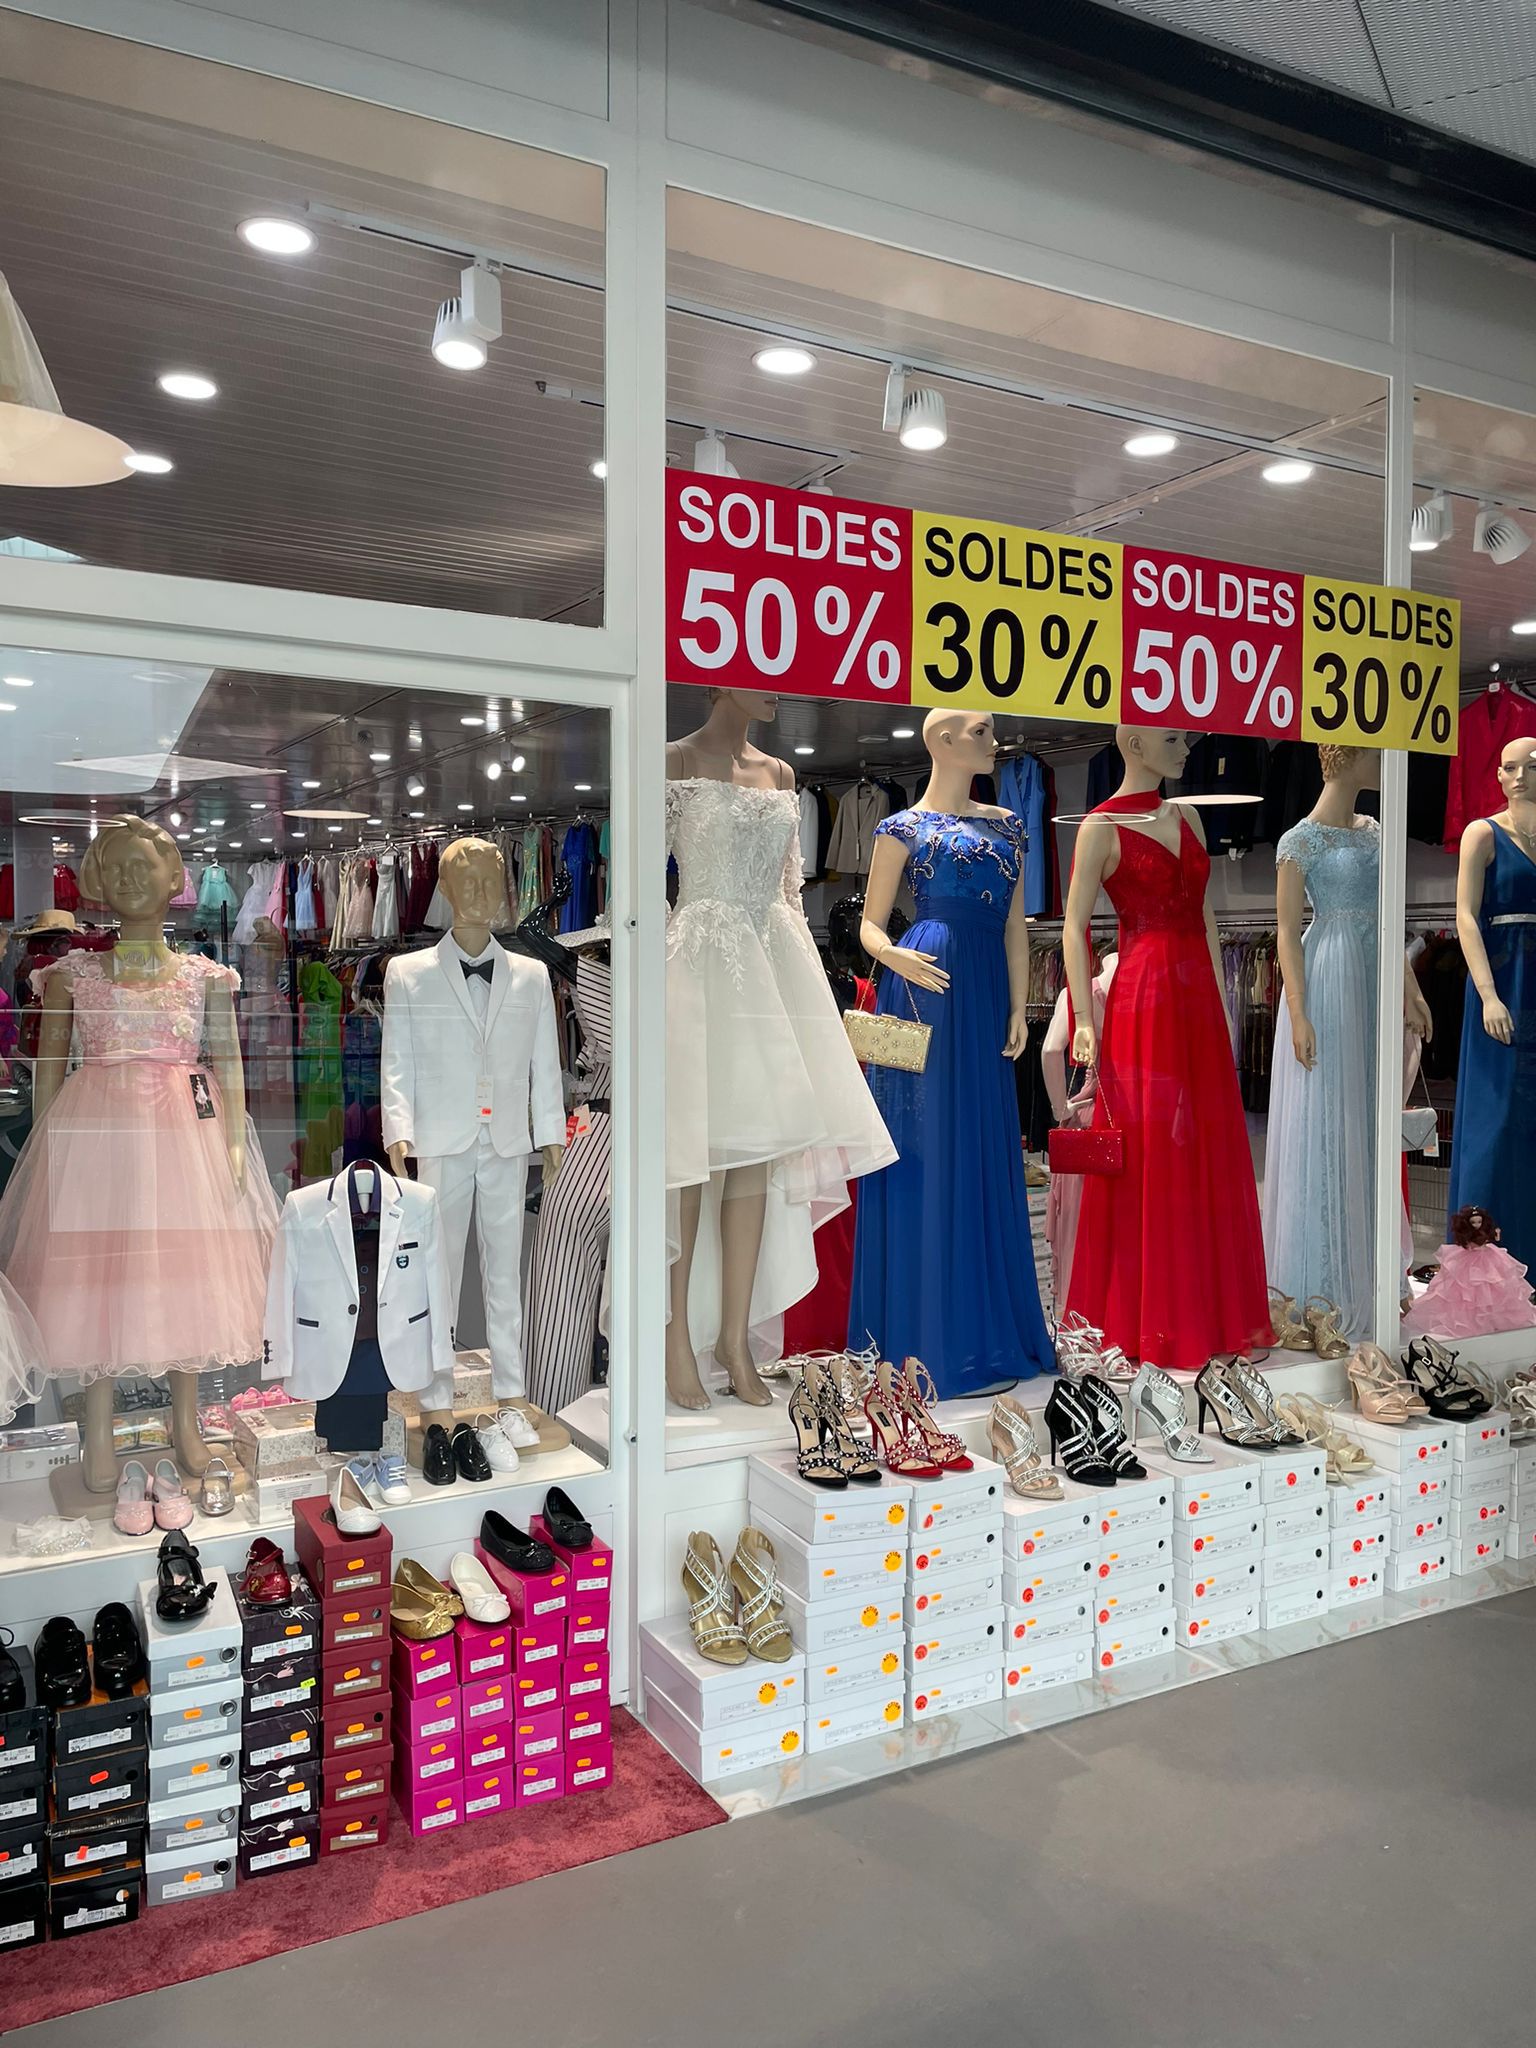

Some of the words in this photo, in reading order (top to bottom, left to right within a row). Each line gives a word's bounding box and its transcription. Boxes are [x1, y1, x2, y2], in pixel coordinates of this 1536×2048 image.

[678, 485, 902, 571] SOLDES
[924, 526, 1113, 600] SOLDES
[1132, 559, 1295, 627] SOLDES
[1312, 588, 1453, 649] SOLDES
